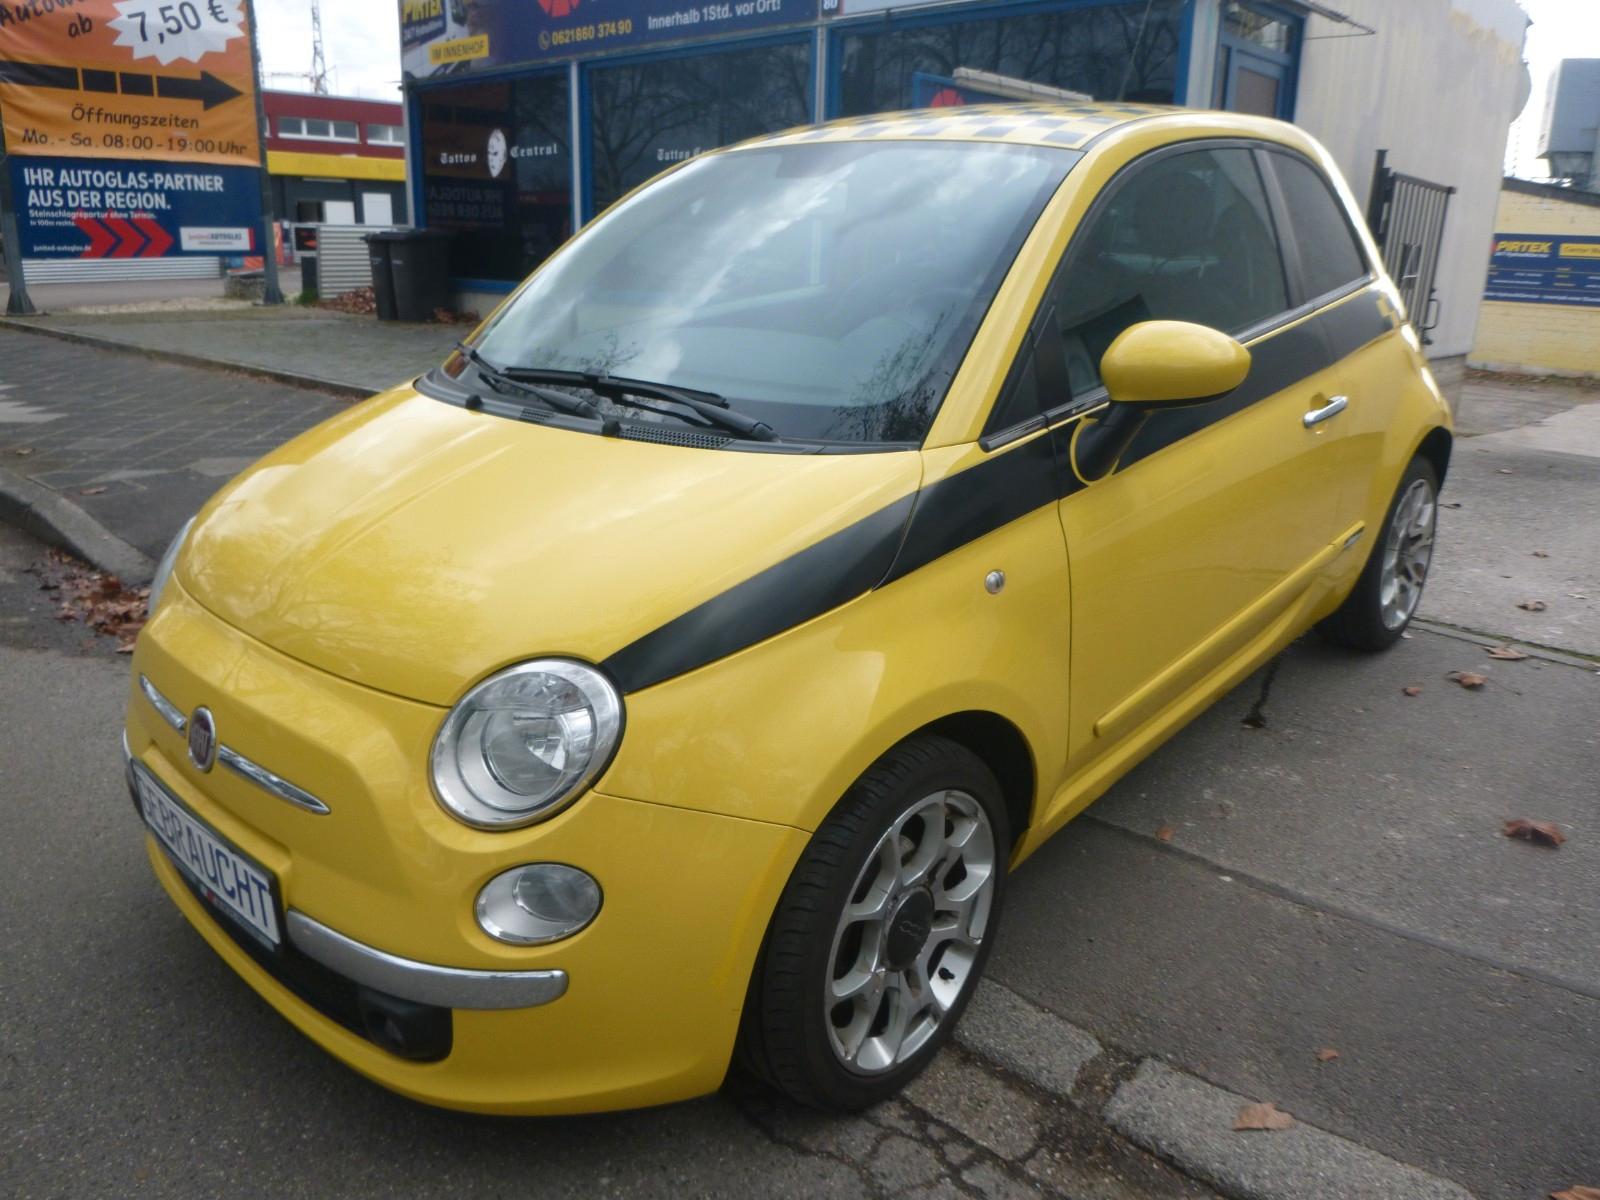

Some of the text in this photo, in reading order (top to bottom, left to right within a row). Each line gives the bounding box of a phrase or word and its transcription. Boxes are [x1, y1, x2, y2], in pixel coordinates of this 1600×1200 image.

[67, 12, 93, 39] ab
[128, 0, 229, 44] 7,50 €
[648, 10, 701, 30] Innerhalb
[702, 4, 733, 22] 1Std.
[735, 2, 757, 16] vor
[71, 102, 200, 130] Öffnungszeiten
[103, 133, 153, 151] 08:00
[167, 137, 216, 154] 19:00
[217, 140, 248, 156] Uhr
[510, 143, 558, 159] Central
[440, 152, 477, 165] Tattoo
[23, 167, 225, 193] IHR AUTOGLAS-PARTNER
[28, 189, 172, 210] AUS DER REGION.
